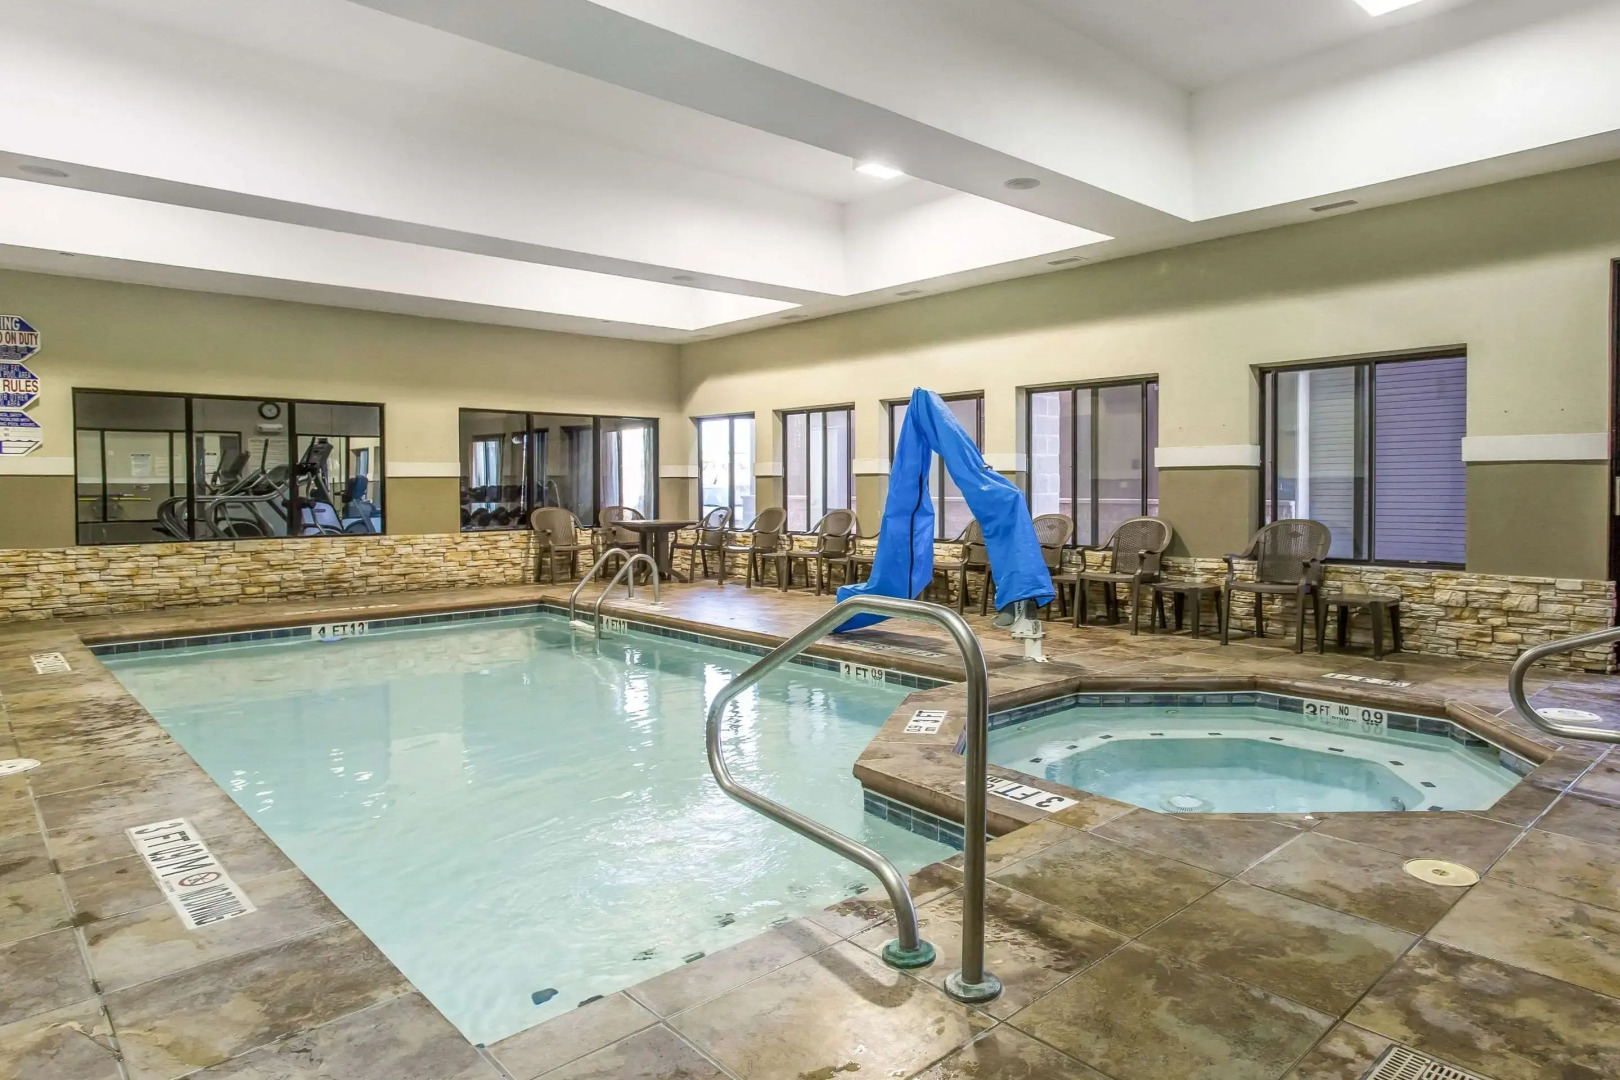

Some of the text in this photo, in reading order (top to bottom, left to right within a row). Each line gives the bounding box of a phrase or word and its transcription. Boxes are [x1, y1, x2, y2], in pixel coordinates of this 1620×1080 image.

[5, 331, 17, 344] ON
[19, 332, 38, 345] DUTY
[3, 379, 39, 393] RULES
[855, 667, 869, 678] FT
[1305, 703, 1330, 716] 3 FT
[1339, 706, 1350, 716] NO
[993, 785, 1043, 801] FT
[1035, 796, 1065, 808] 3
[143, 831, 191, 848] FT
[155, 855, 216, 878] M
